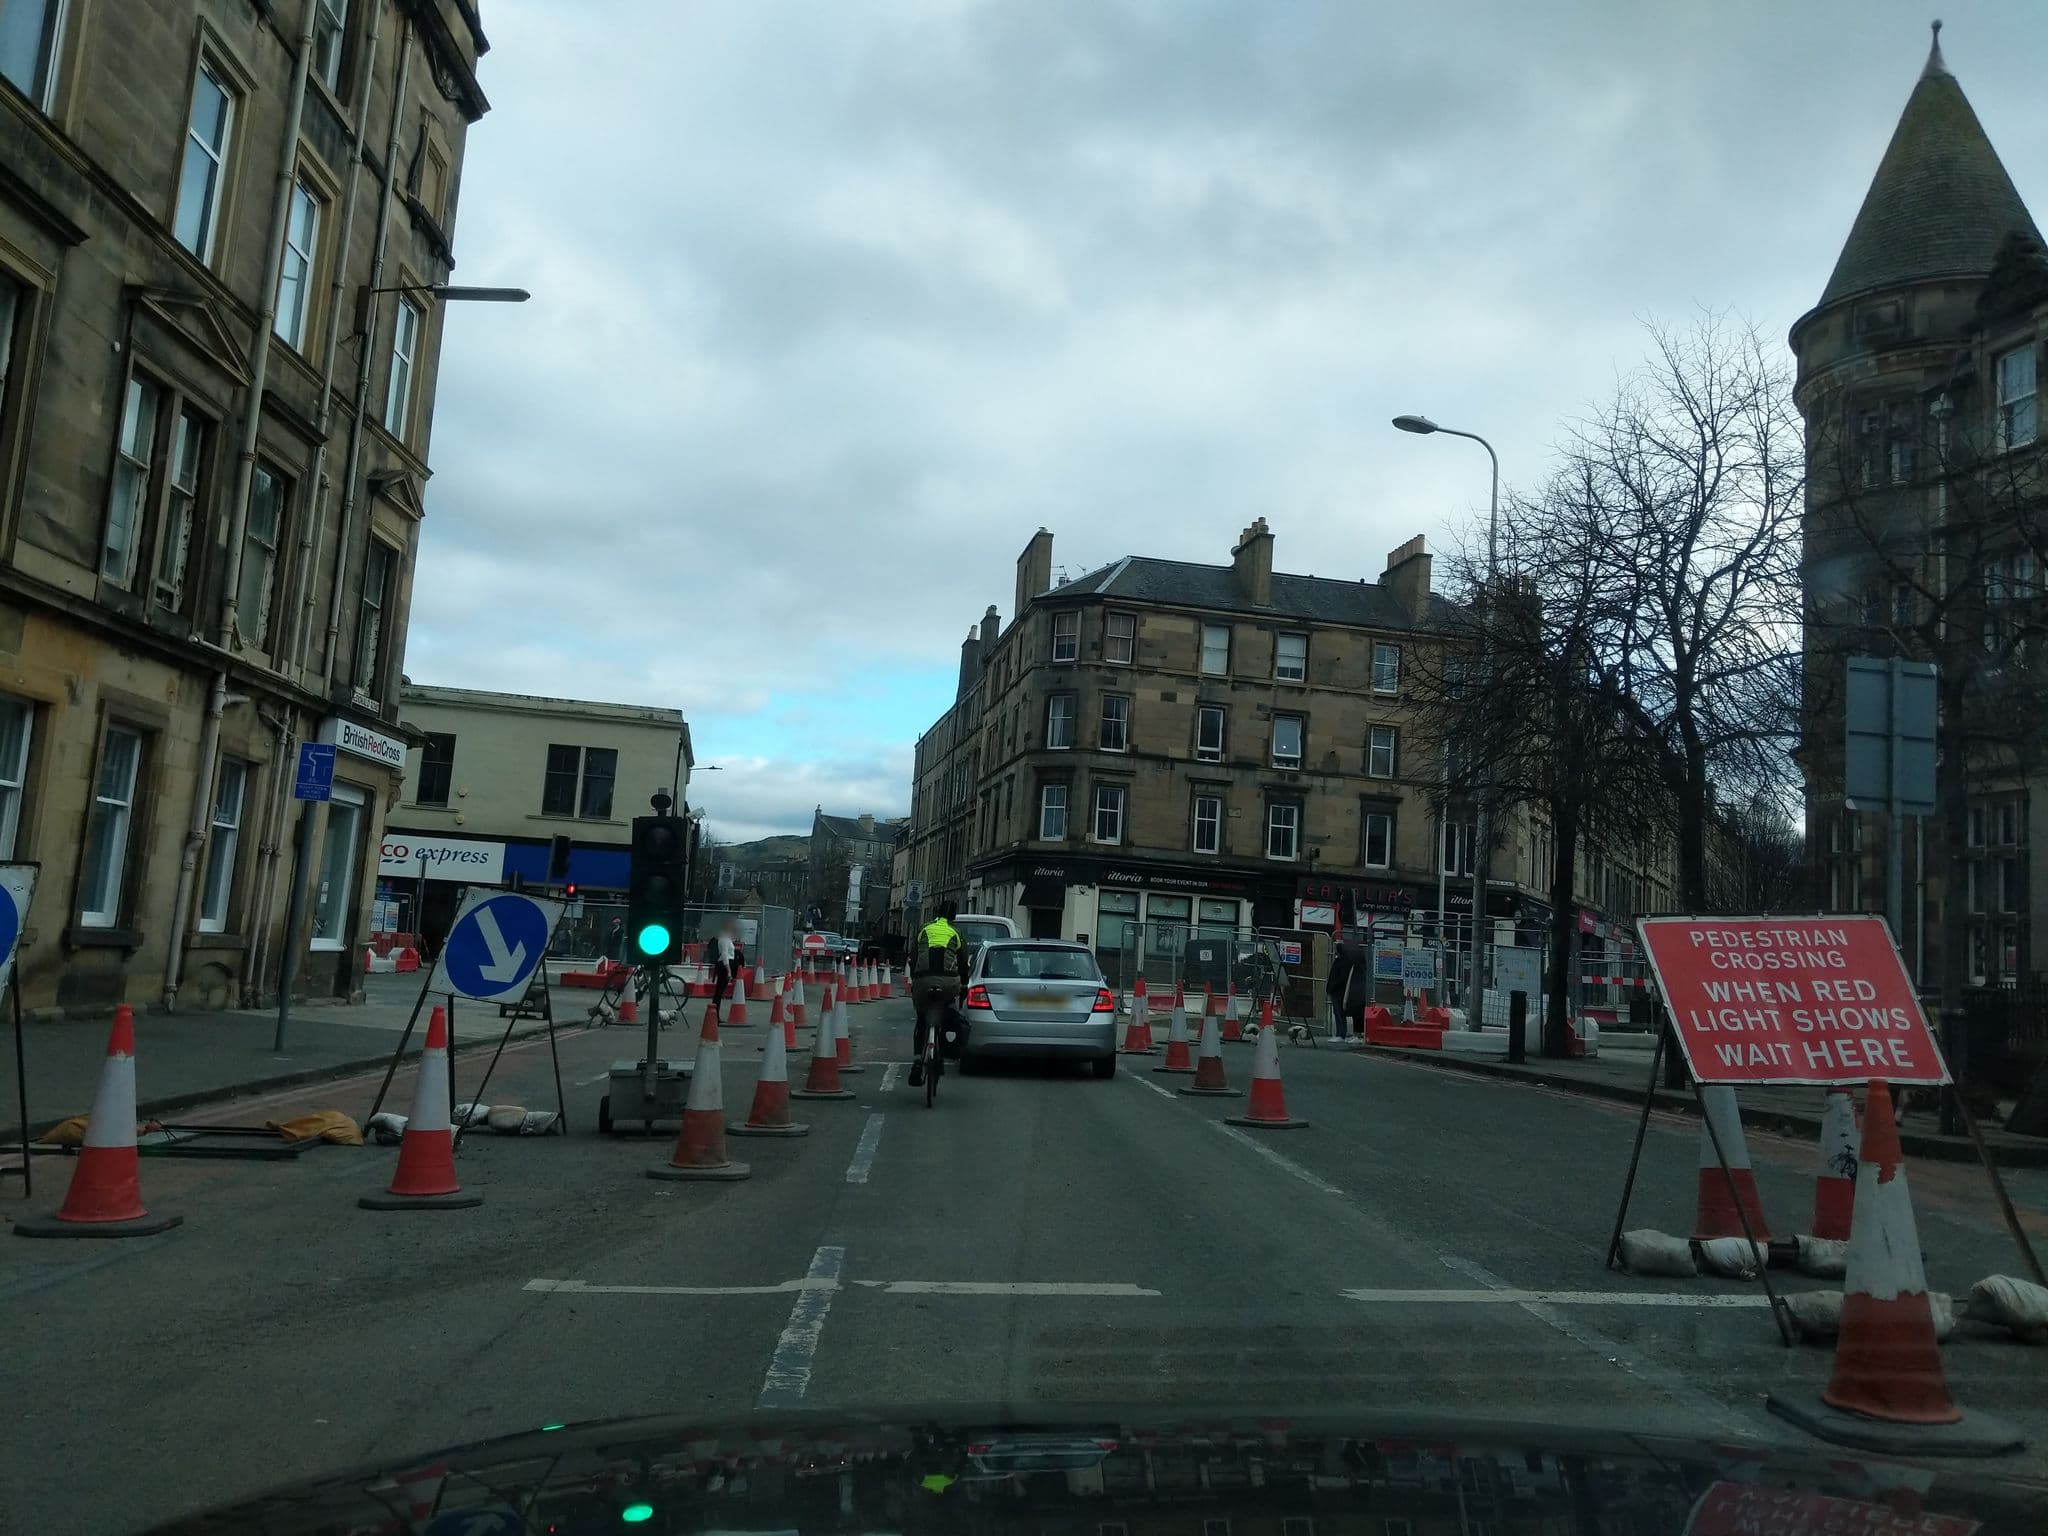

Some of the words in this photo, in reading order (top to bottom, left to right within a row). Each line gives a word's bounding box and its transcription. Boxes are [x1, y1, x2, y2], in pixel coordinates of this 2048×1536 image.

[415, 847, 489, 865] express
[1177, 879, 1192, 887] EVENT
[1689, 929, 1849, 948] PEDESTRIAN
[1710, 950, 1847, 971] CROSSING
[1702, 980, 1802, 1004] WHEN
[1811, 979, 1878, 1002] RED
[1690, 1008, 1782, 1033] LIGHT
[1792, 1007, 1911, 1032] SHOWS
[1714, 1043, 1793, 1067] WAIT
[1802, 1038, 1915, 1069] HERE
